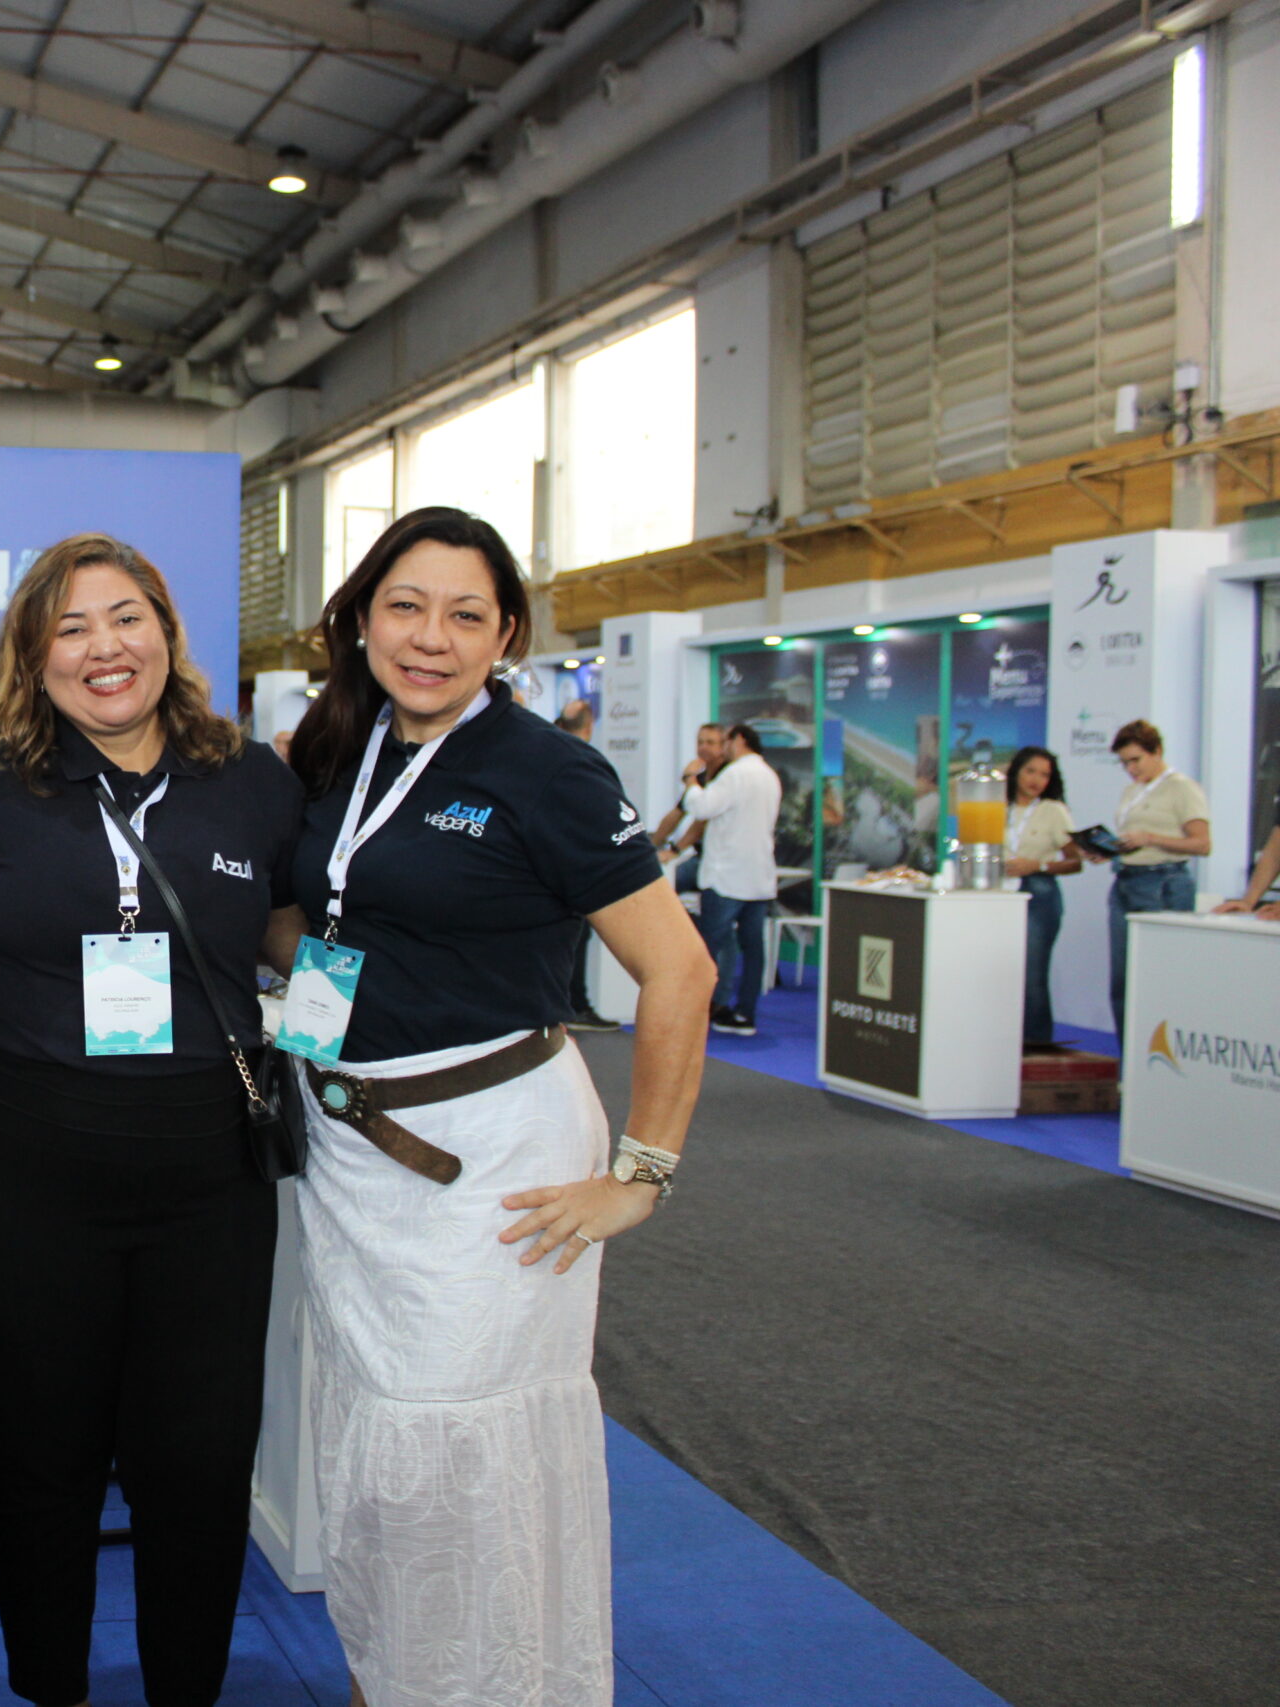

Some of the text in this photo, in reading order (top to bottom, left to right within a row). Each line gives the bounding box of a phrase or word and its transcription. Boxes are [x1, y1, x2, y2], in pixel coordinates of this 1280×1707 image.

[424, 811, 485, 838] viagens
[443, 801, 493, 824] Azul
[211, 852, 253, 880] Azul
[831, 1000, 874, 1024] PORTO
[1174, 1028, 1280, 1078] MARINA
